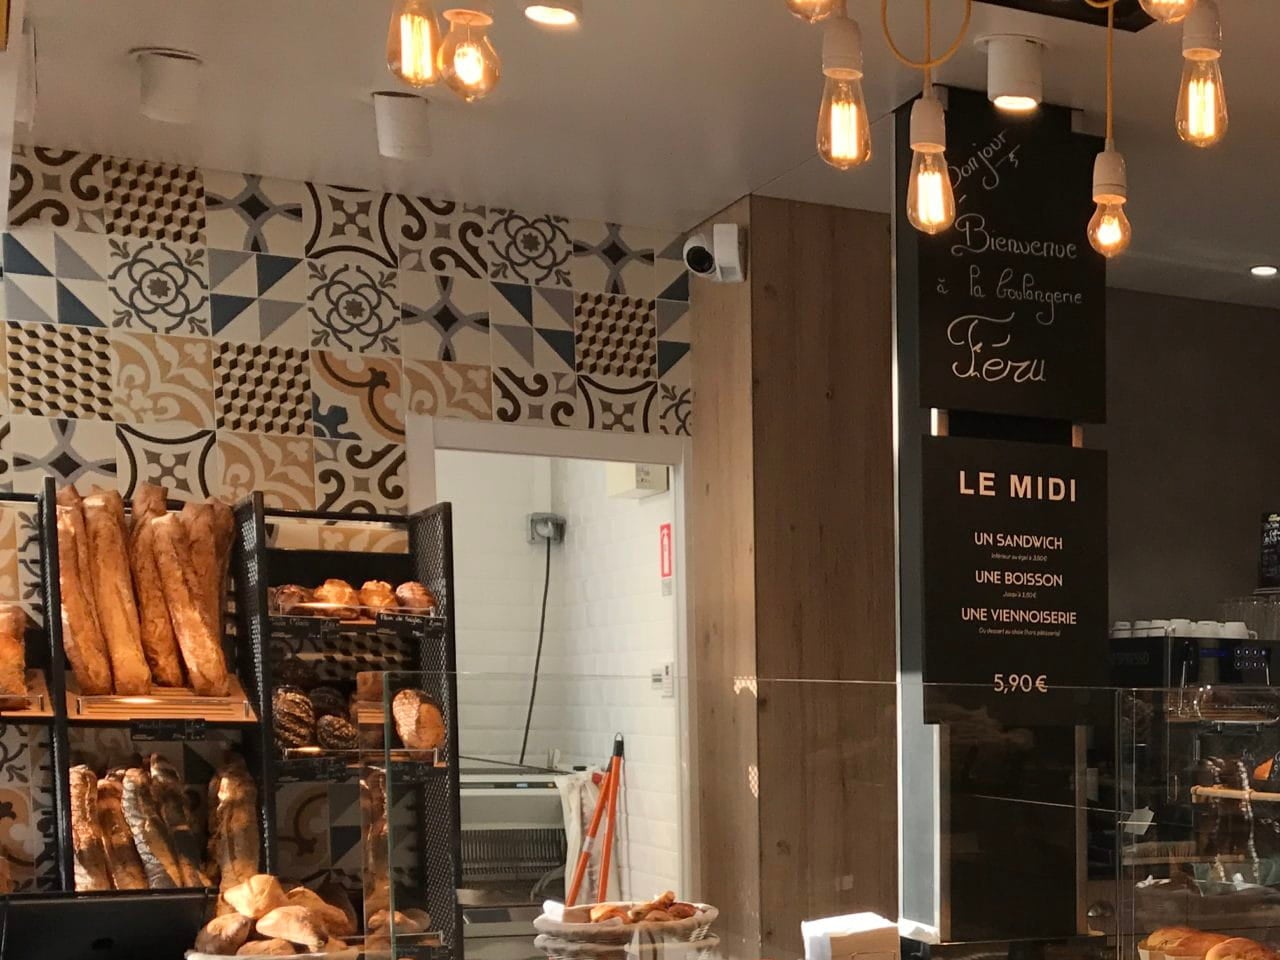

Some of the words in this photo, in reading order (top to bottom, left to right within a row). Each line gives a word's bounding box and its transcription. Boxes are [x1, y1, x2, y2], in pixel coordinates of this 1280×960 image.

[951, 213, 1078, 258] Bienvenue
[969, 264, 987, 298] la
[996, 268, 1083, 325] boulangerie
[959, 470, 996, 496] LE
[1010, 474, 1076, 502] MIDI
[974, 531, 993, 546] UN
[996, 533, 1063, 550] SANDWICH
[975, 570, 1001, 585] UNE
[1004, 571, 1063, 587] BOISSON
[961, 607, 988, 621] UNE
[991, 608, 1077, 625] VIENNOISERIE
